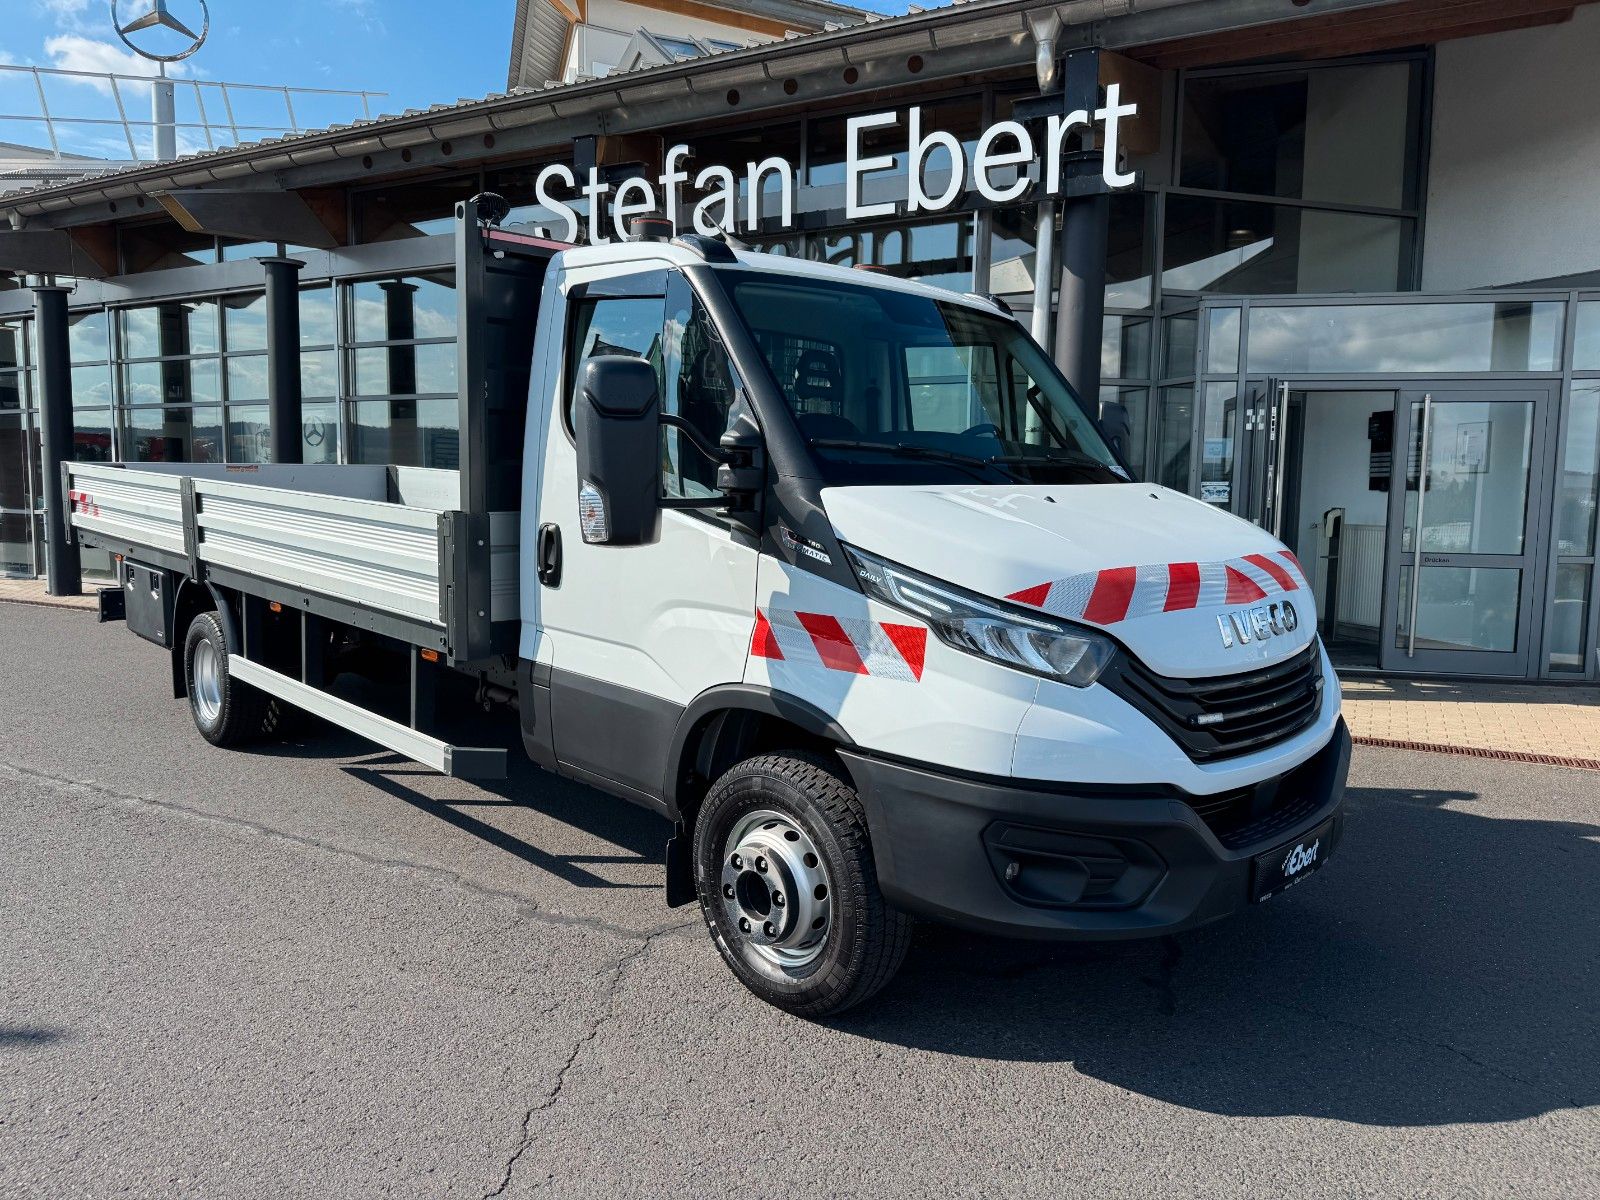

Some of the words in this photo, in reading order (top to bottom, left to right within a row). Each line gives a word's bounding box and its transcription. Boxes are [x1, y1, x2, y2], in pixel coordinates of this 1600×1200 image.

[534, 144, 792, 246] Stefan
[846, 83, 1138, 220] Ebert
[859, 569, 882, 584] DAILY
[1216, 600, 1298, 650] IVECO
